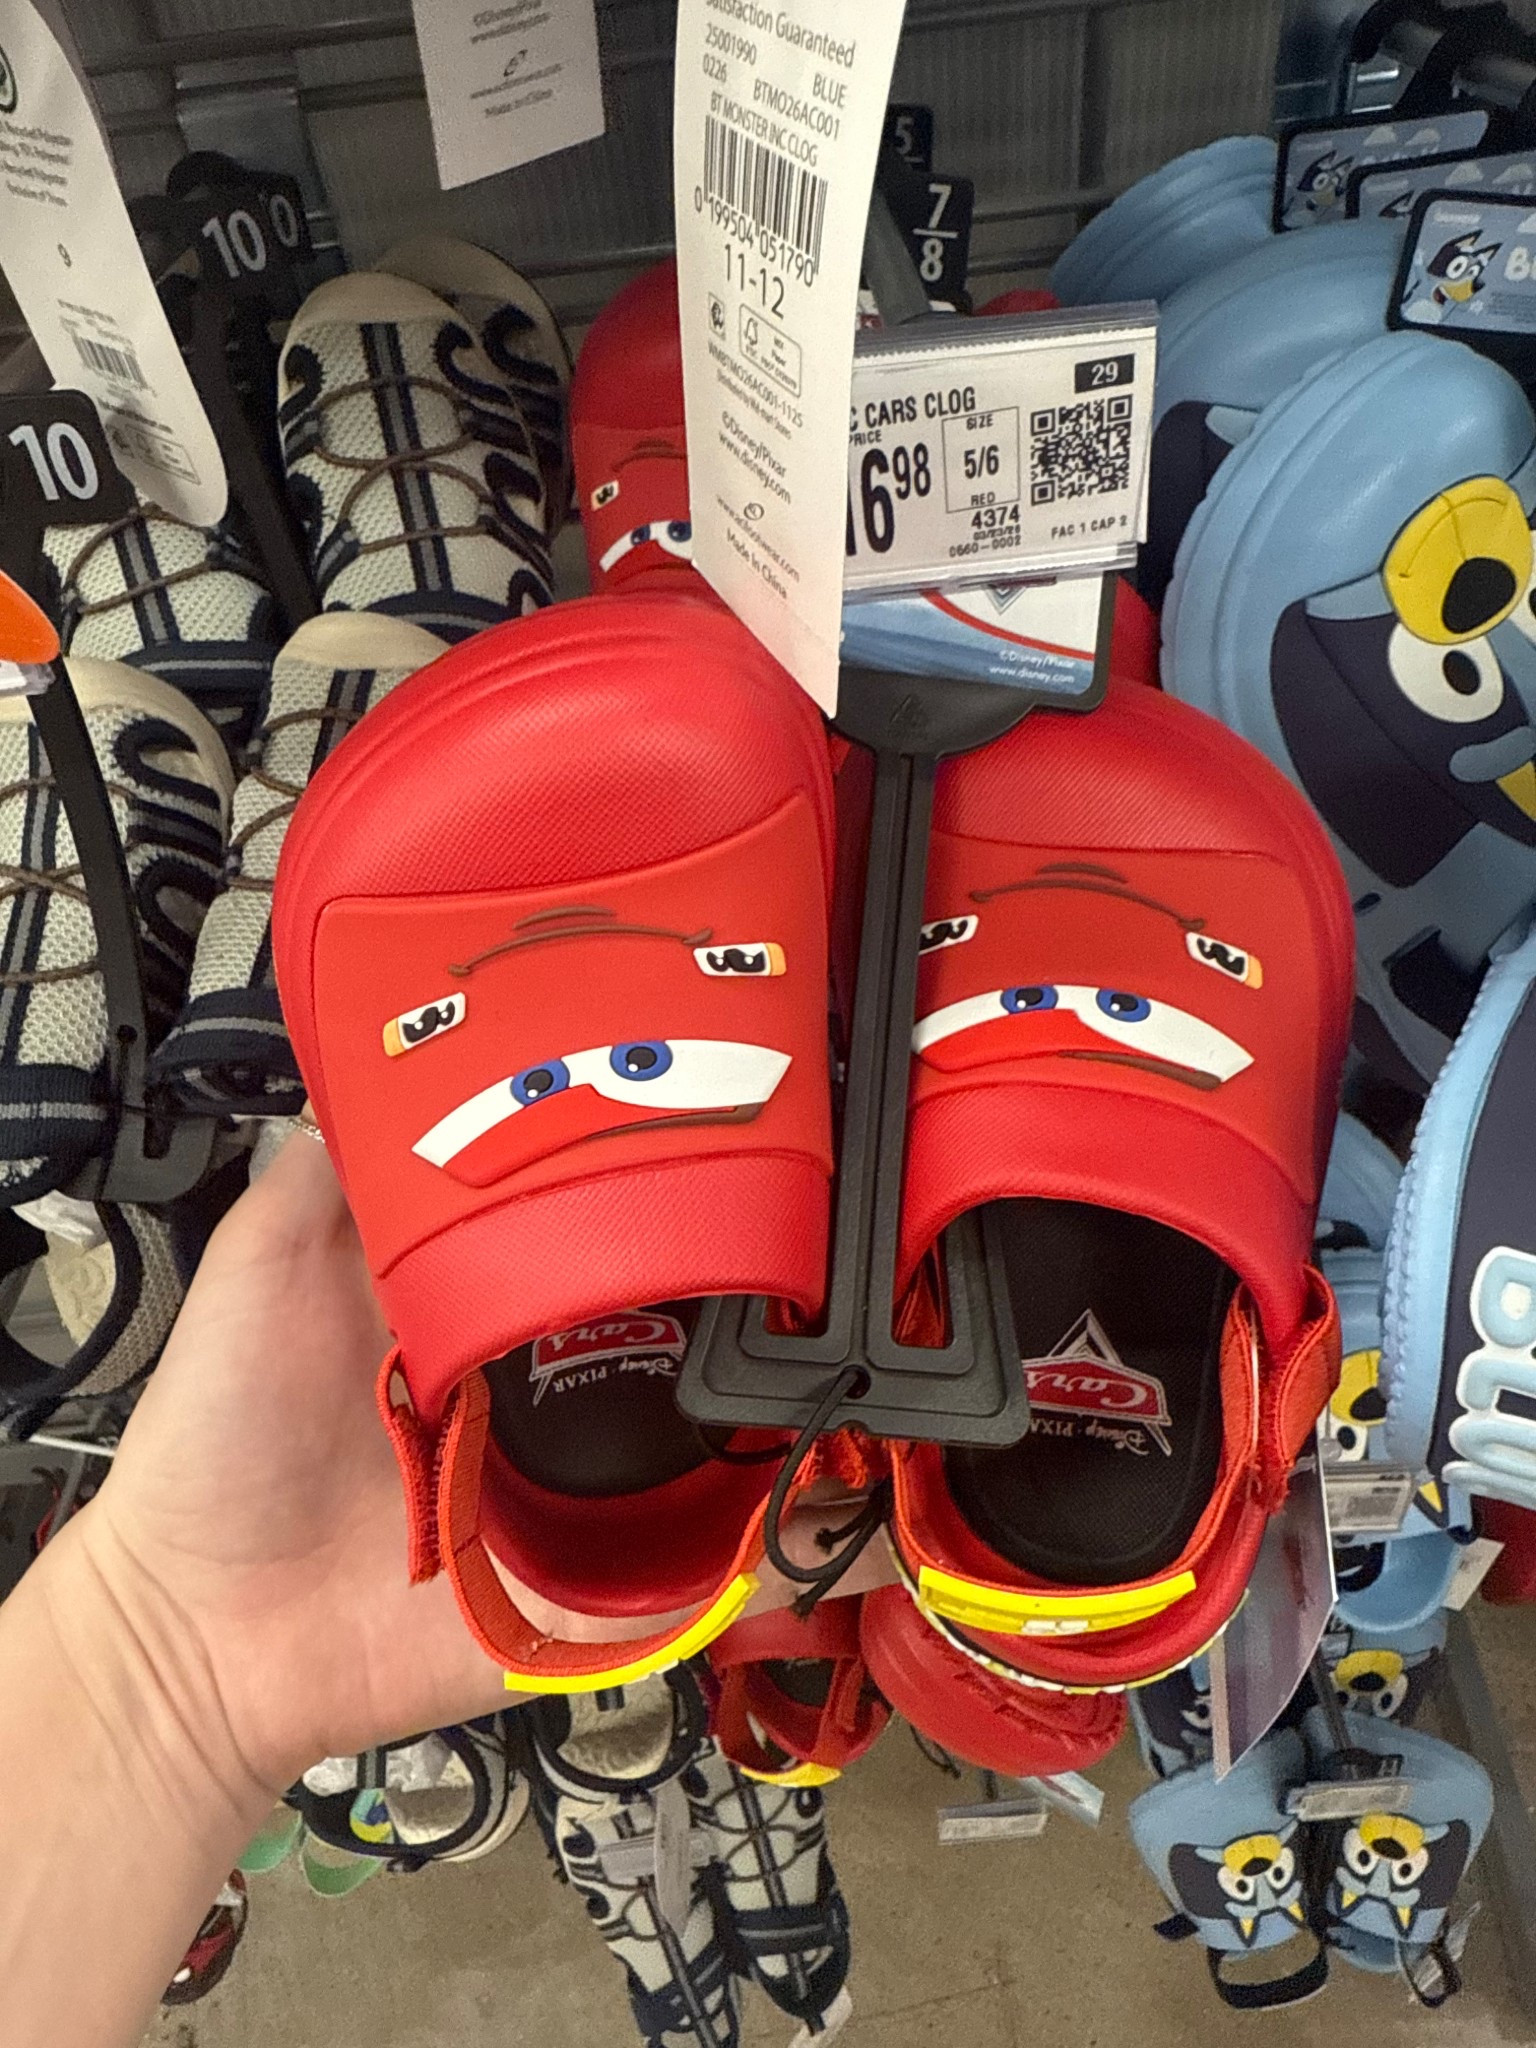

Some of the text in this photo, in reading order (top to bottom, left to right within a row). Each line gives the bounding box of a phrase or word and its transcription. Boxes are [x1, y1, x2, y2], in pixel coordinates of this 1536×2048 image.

[705, 22, 757, 66] 25001990
[775, 12, 856, 68] Guaranteed
[703, 53, 727, 83] 0226
[812, 72, 848, 109] BLUE
[711, 90, 722, 113] BT
[723, 98, 768, 141] MONSTER
[787, 134, 818, 167] CLOG
[202, 209, 267, 278] 10
[724, 243, 784, 320] 11-12
[1091, 361, 1119, 386] 29
[865, 395, 917, 429] CARS
[924, 386, 976, 418] CLOG
[966, 413, 994, 431] SIZE
[8, 421, 99, 501] 10
[964, 444, 1000, 480] 5/6
[971, 491, 996, 507] RED
[971, 504, 1020, 530] 4374
[1051, 515, 1128, 540] FAC 1 CAP 2
[726, 528, 750, 562] Made
[761, 565, 788, 600] China
[546, 1320, 667, 1352] Cars
[553, 1357, 679, 1393] Disney PIXAR
[1025, 1370, 1149, 1409] Cars
[1030, 1417, 1150, 1456] Disney PIXA
